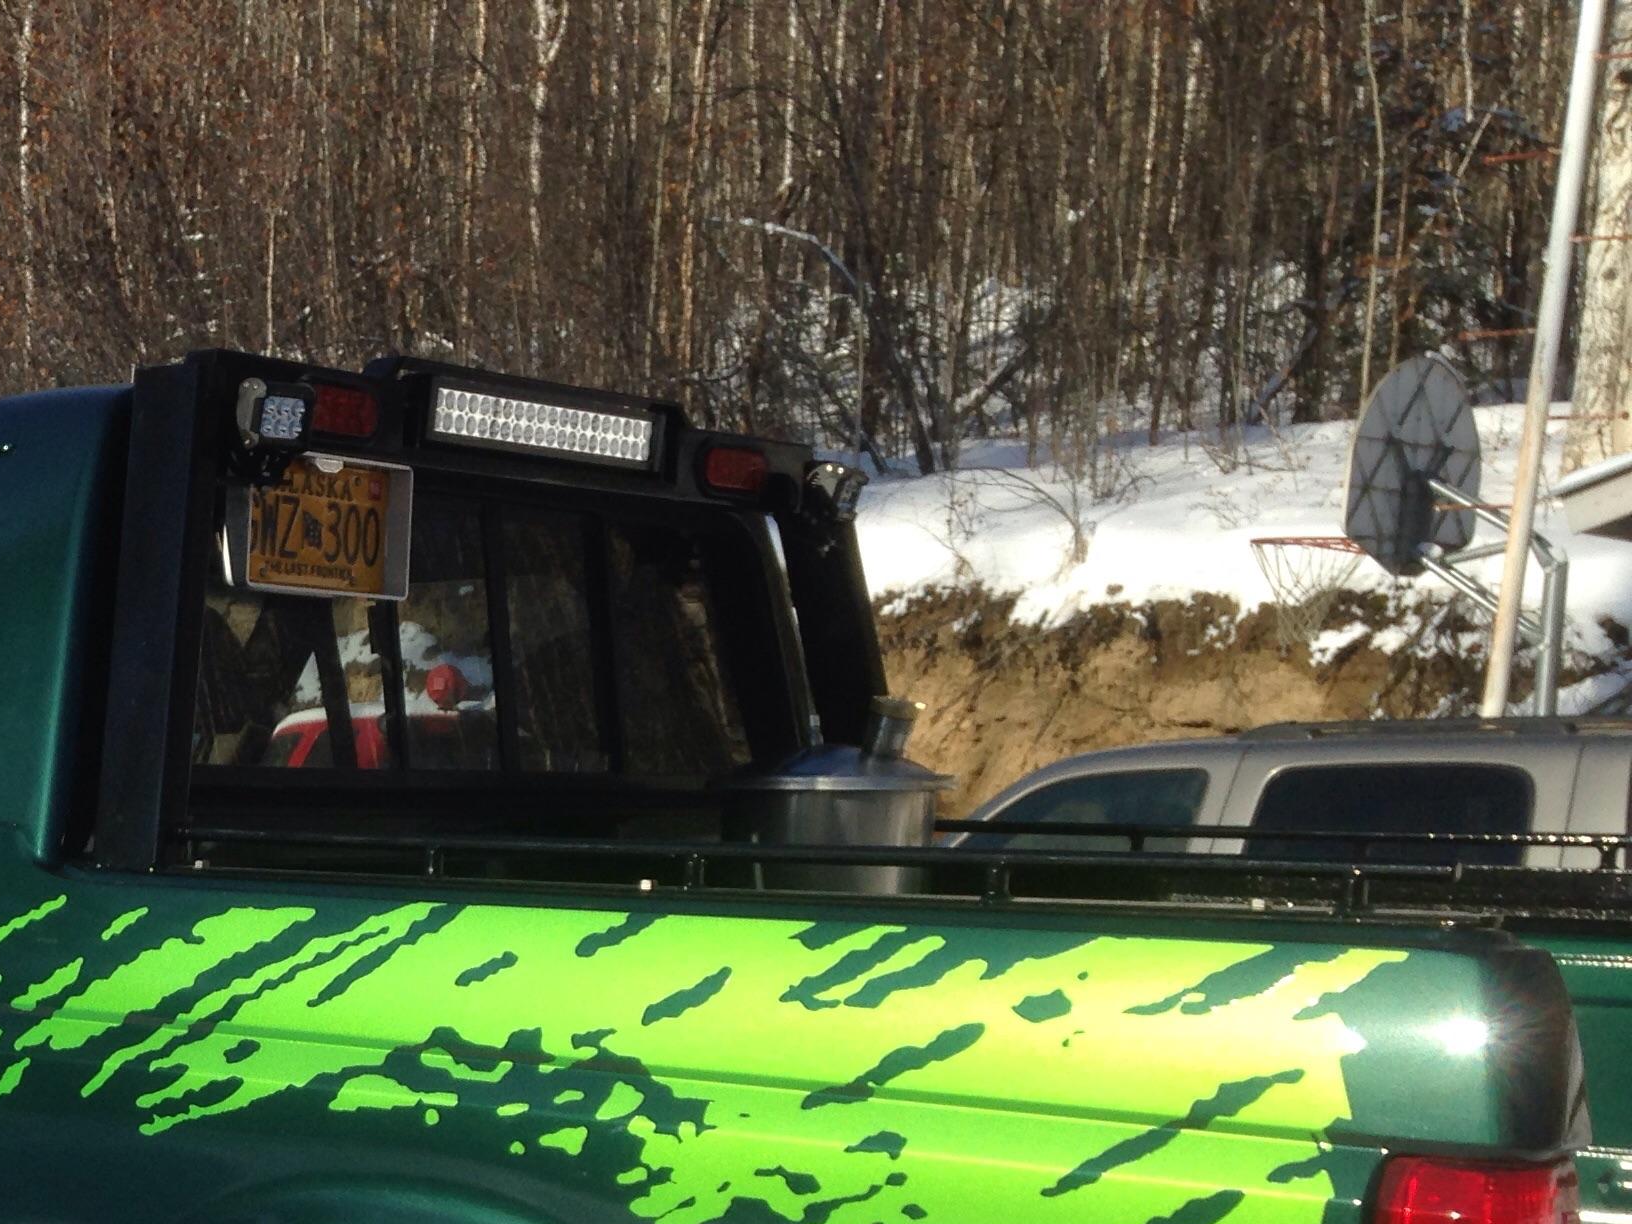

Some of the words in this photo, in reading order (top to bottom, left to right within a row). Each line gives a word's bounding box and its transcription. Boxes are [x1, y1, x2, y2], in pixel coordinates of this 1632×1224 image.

[273, 470, 353, 502] LASKA
[325, 500, 380, 567] 300
[284, 561, 308, 576] LAST
